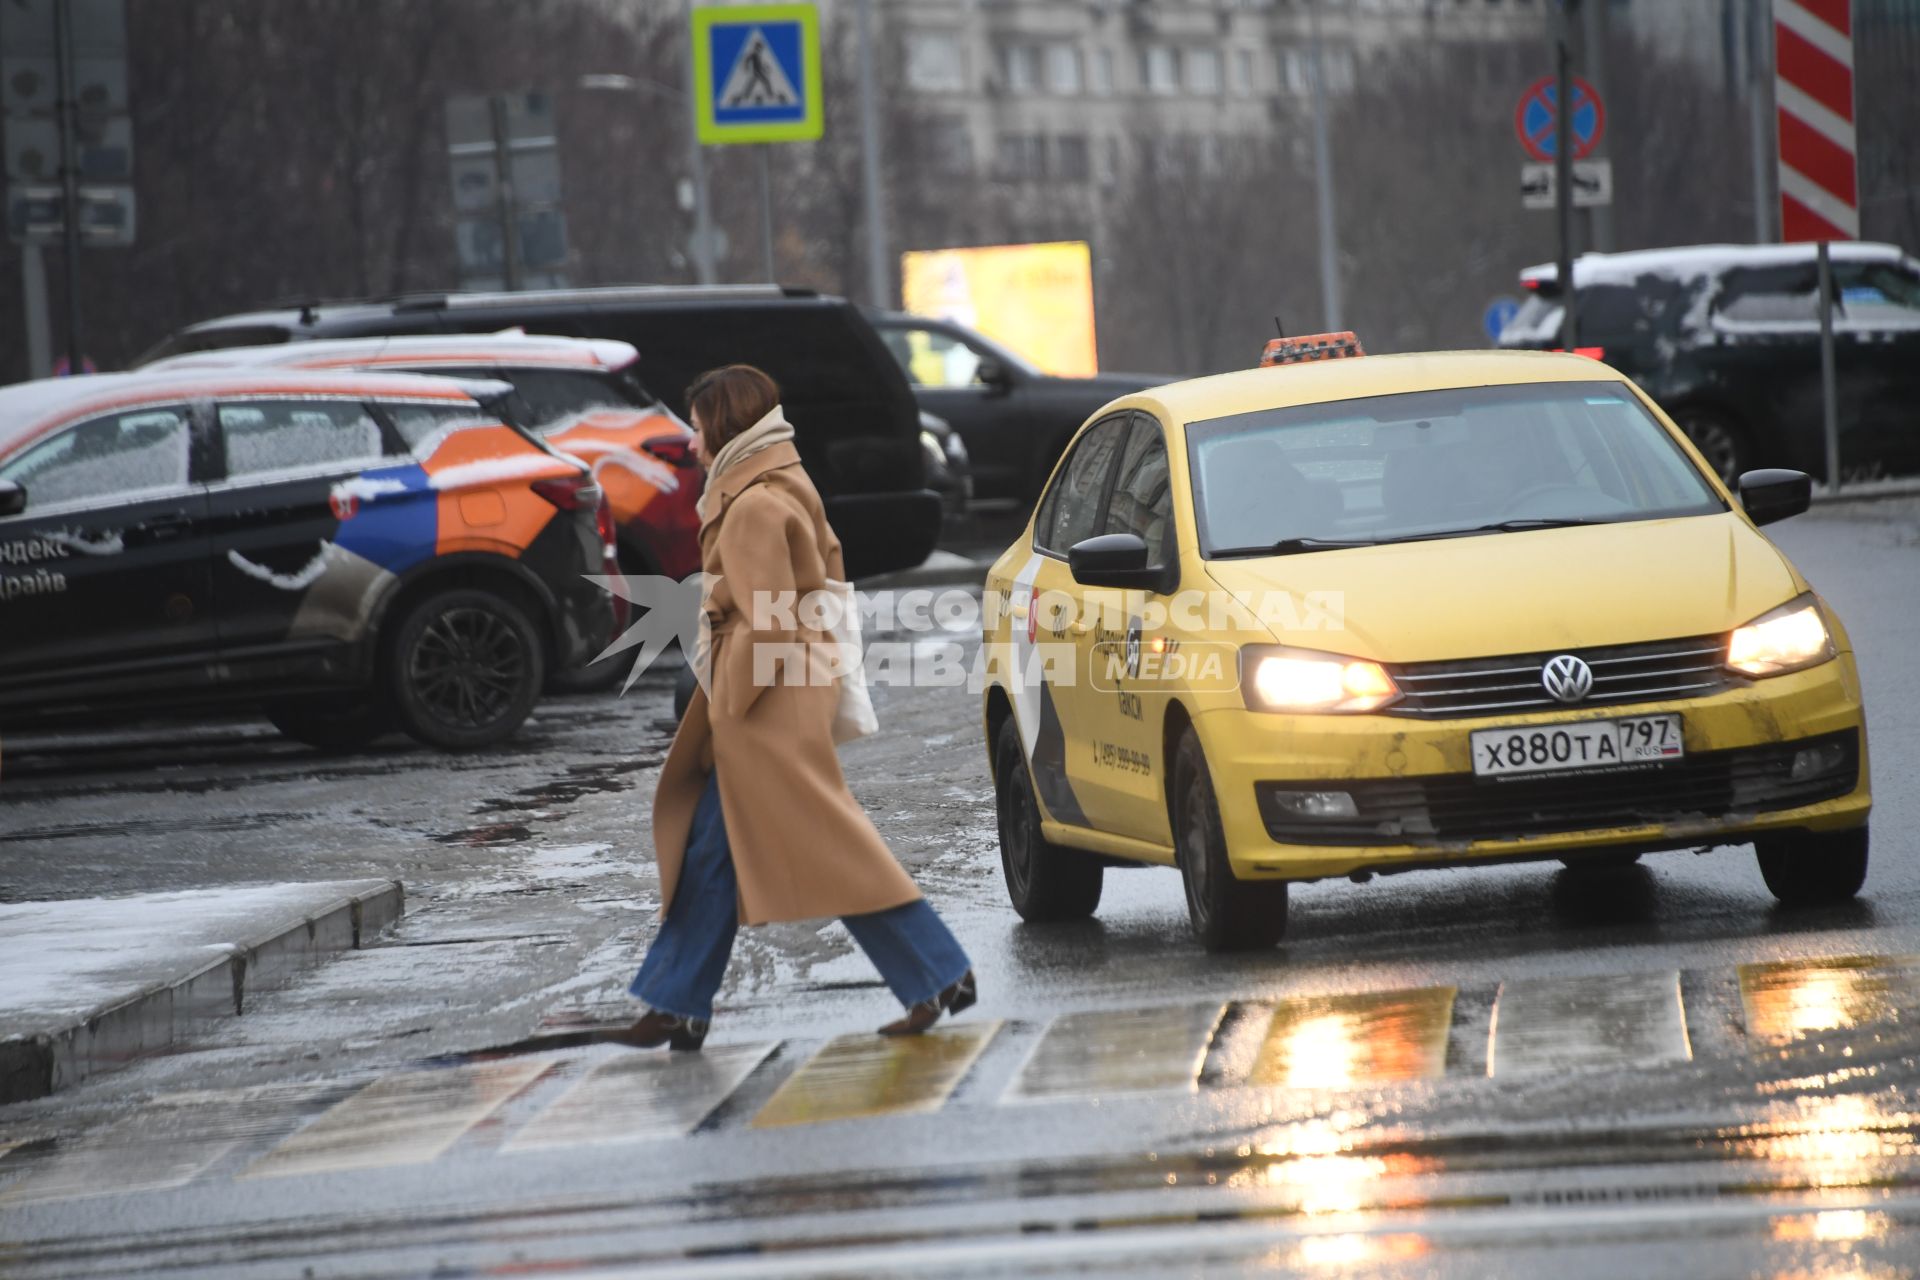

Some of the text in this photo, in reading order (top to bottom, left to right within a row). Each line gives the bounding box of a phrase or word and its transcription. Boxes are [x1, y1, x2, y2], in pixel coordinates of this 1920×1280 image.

[0, 567, 67, 600] райв
[1486, 720, 1669, 769] Х880ТА 797
[1635, 745, 1661, 757] RUS
